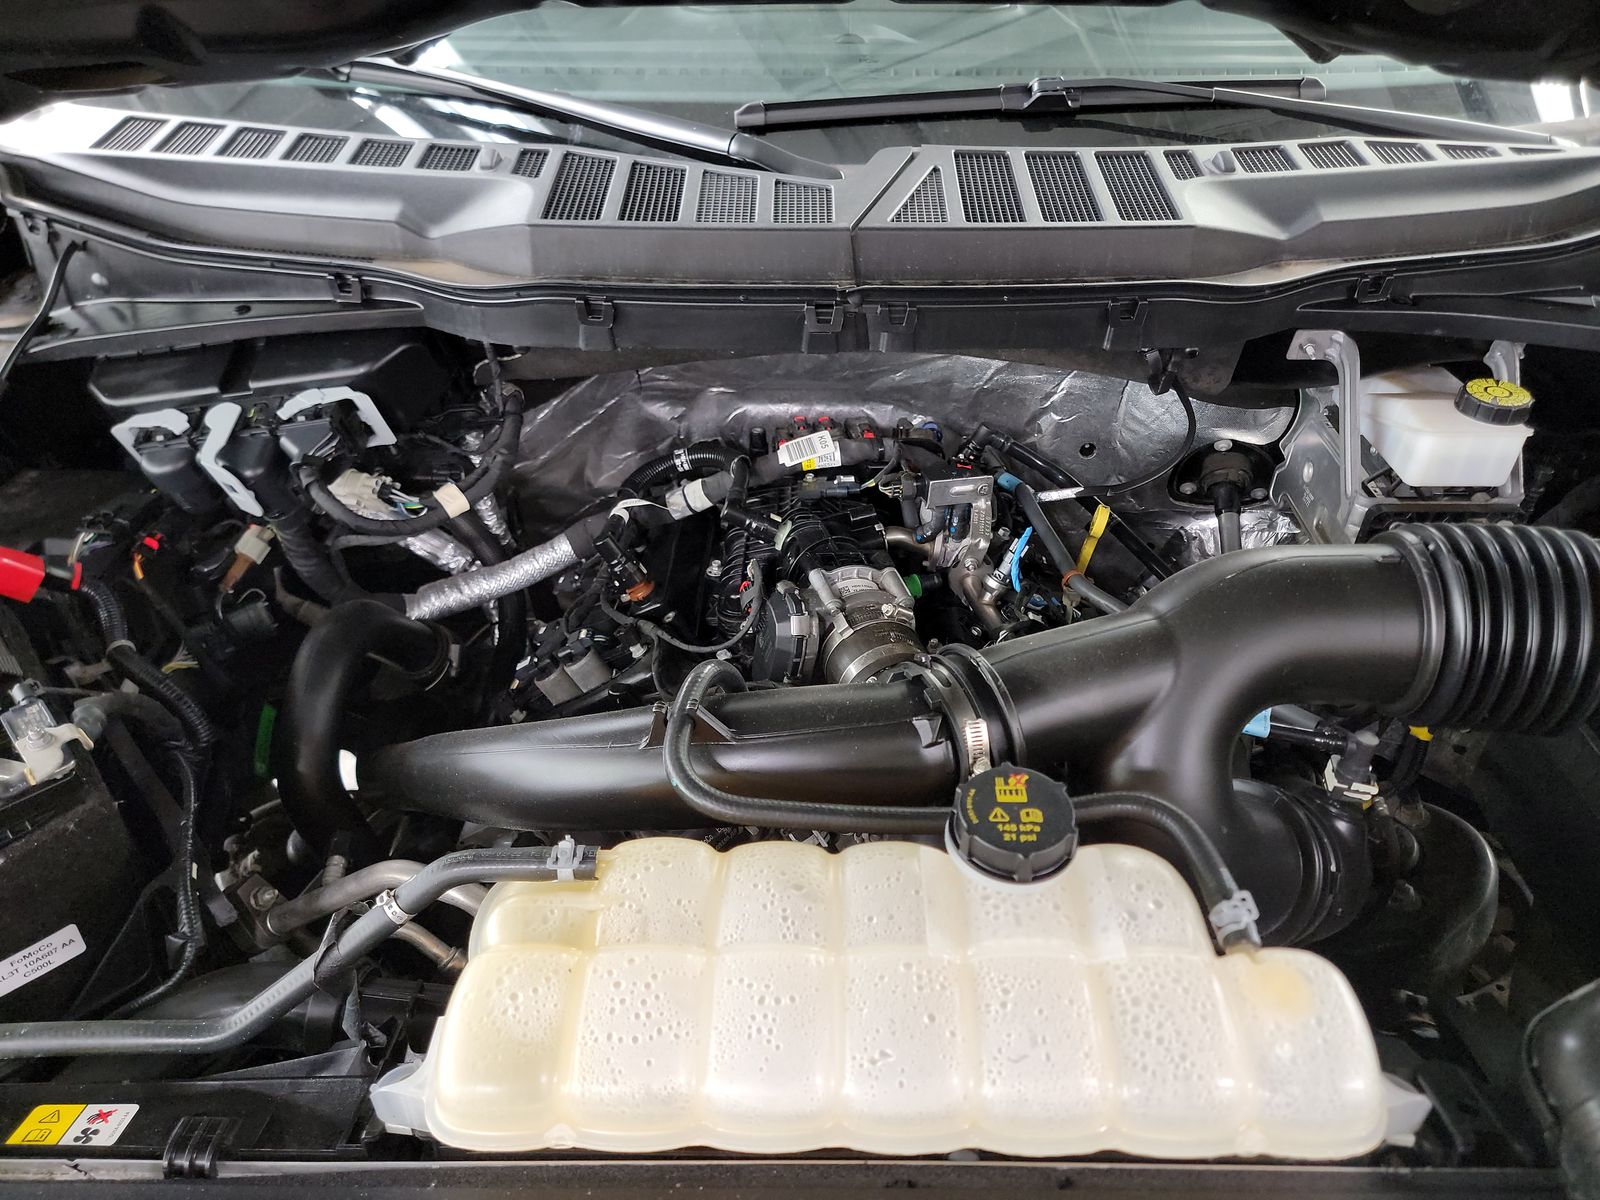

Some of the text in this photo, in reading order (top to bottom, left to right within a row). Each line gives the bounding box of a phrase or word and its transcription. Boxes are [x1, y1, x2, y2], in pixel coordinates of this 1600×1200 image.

[817, 435, 829, 449] K05
[1020, 833, 1037, 843] psi
[61, 938, 76, 950] AA
[10, 942, 53, 967] FoMoCo
[23, 959, 56, 978] C500L
